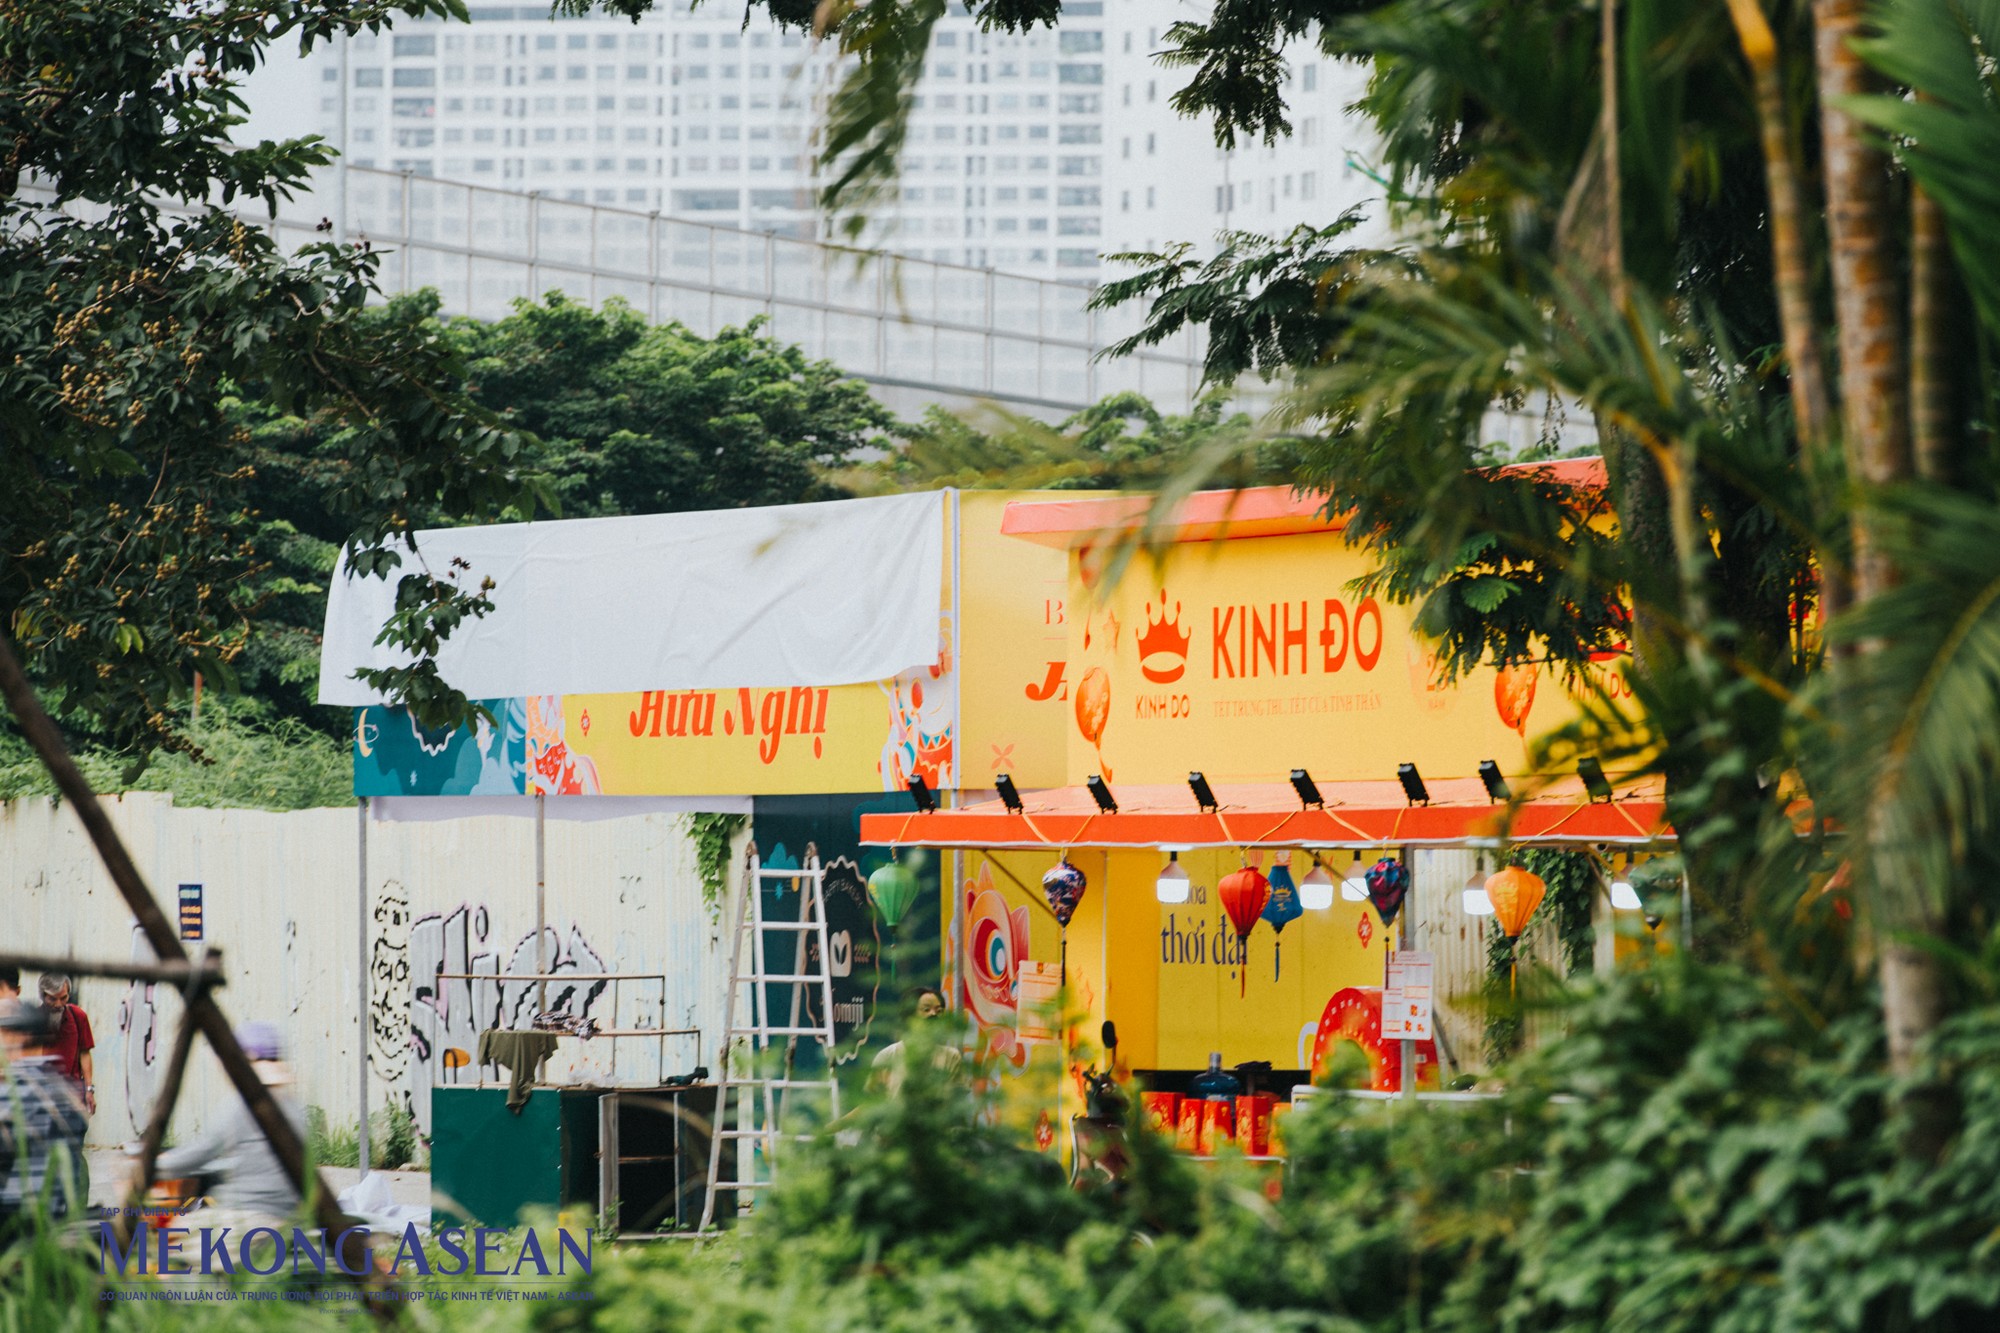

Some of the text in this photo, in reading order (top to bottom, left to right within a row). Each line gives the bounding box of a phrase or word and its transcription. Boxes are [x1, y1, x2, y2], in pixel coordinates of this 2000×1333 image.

[1212, 600, 1308, 680] KINH
[1135, 695, 1167, 720] KINH
[1160, 913, 1206, 966] thời
